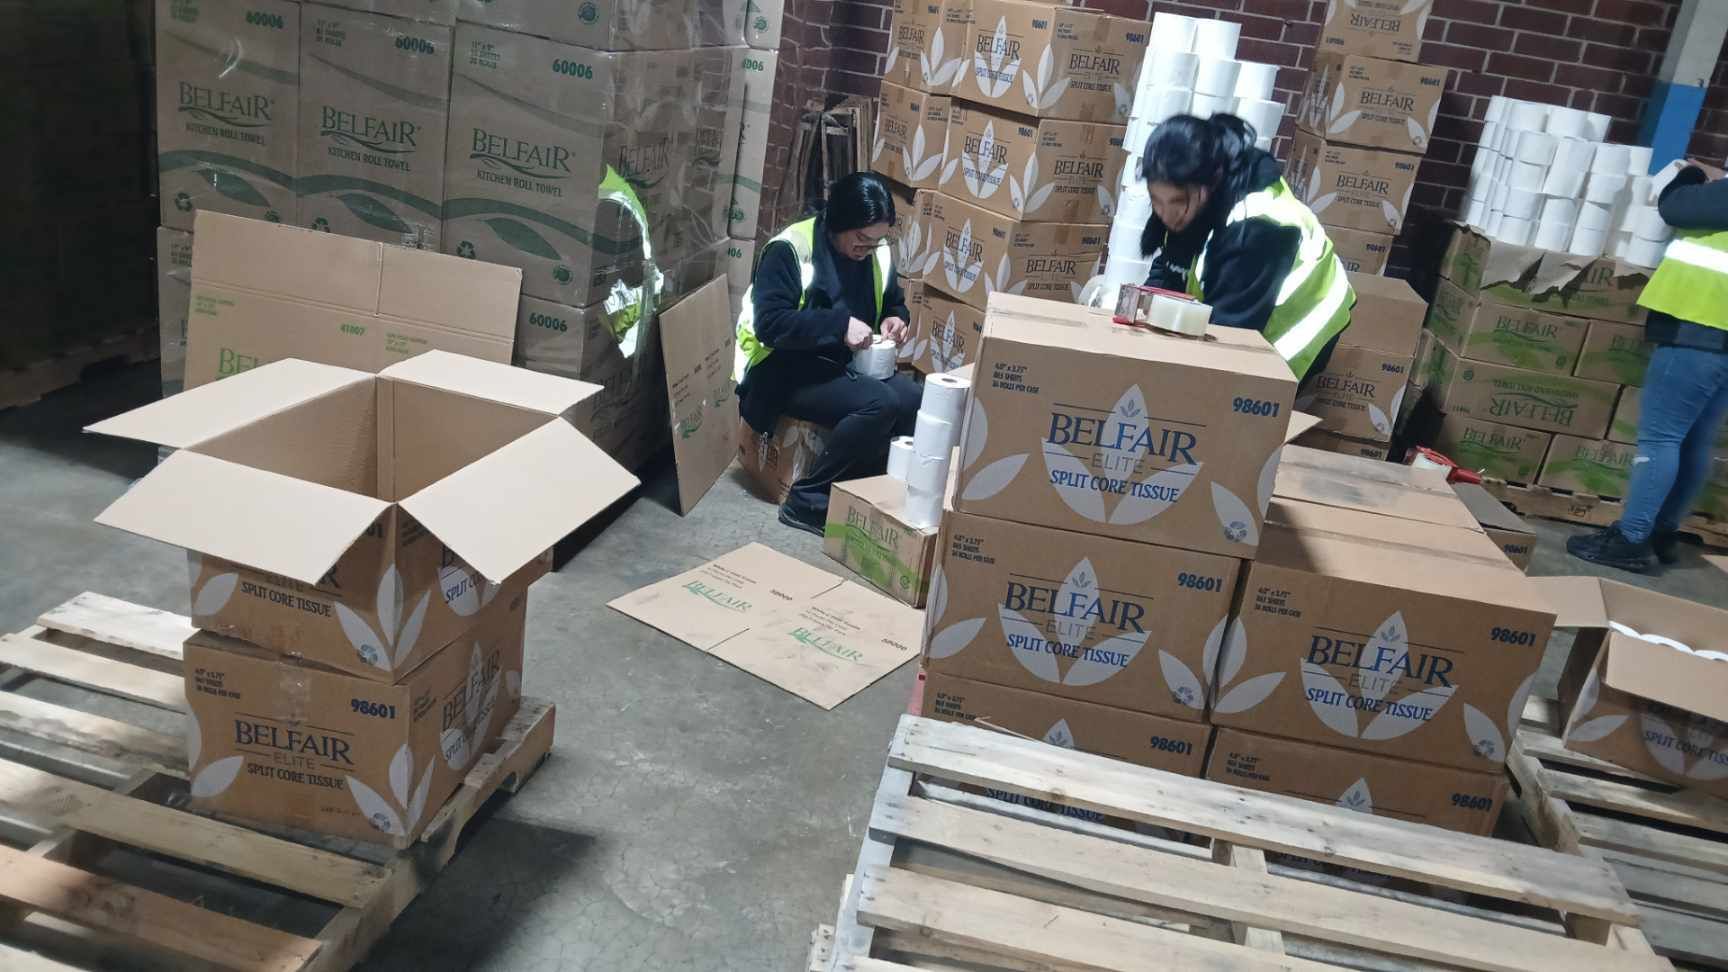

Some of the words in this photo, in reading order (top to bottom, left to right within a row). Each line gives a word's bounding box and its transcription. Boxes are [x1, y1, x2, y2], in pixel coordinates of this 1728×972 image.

[1350, 13, 1400, 32] BELFAIR
[395, 36, 434, 54] 60006
[976, 34, 1021, 60] BELFAIR
[552, 58, 593, 80] 60006
[1069, 54, 1121, 75] BELFAIR
[178, 82, 272, 120] BELFAIR
[1360, 91, 1414, 112] BELFAIR
[321, 106, 416, 147] BELFAIR
[328, 148, 361, 162] KITCHEN
[363, 154, 383, 166] ROLL
[472, 128, 572, 172] BELFAIR
[964, 136, 1008, 163] BELFAIR
[1054, 160, 1104, 179] BELFAIR
[477, 168, 512, 186] KITCHEN
[514, 177, 533, 192] ROLL
[536, 182, 562, 198] TOWEL
[1336, 174, 1389, 194] BELFAIR
[945, 230, 984, 263] BELFAIR
[1026, 258, 1076, 276] BELFAIR
[529, 312, 568, 332] 60006
[1497, 315, 1560, 338] BELFAIR
[1382, 362, 1404, 374] 98601
[1316, 375, 1376, 398] BELFAIR
[1232, 396, 1280, 418] 98601
[1490, 398, 1575, 426] BELFAIR
[1047, 412, 1198, 466] BELFAIR
[1464, 428, 1521, 450] BELFAIR
[1092, 453, 1144, 474] ELITE
[1050, 470, 1088, 490] SPLIT
[1090, 475, 1126, 494] CORE
[1131, 482, 1180, 502] TISSUE
[848, 505, 898, 547] BELFAIR
[1178, 572, 1222, 593] 98601
[240, 581, 267, 600] SPLIT
[268, 590, 295, 608] CORE
[296, 596, 332, 618] TISSUE
[688, 580, 752, 612] BELFAIR
[1004, 581, 1145, 634] BELFAIR
[1046, 619, 1096, 640] ELITE
[1491, 627, 1536, 646] 98601
[792, 627, 864, 662] BELFAIR
[1008, 633, 1042, 652] SPLIT
[1044, 640, 1078, 658] CORE
[1082, 648, 1128, 668] TISSUE
[1306, 634, 1454, 688] BELFAIR
[1348, 672, 1398, 693] ELITE
[351, 698, 396, 719] 98601
[1307, 686, 1345, 706] SPLIT
[1346, 696, 1382, 714] CORE
[1385, 700, 1432, 721] TISSUE
[234, 720, 354, 766] BELFAIR
[1150, 736, 1192, 756] 98601
[1646, 730, 1673, 748] SPLIT
[274, 752, 316, 770] ELITE
[248, 763, 274, 778] SPLIT
[276, 766, 305, 784] CORE
[307, 774, 344, 790] TISSUE
[1451, 794, 1493, 812] 98601
